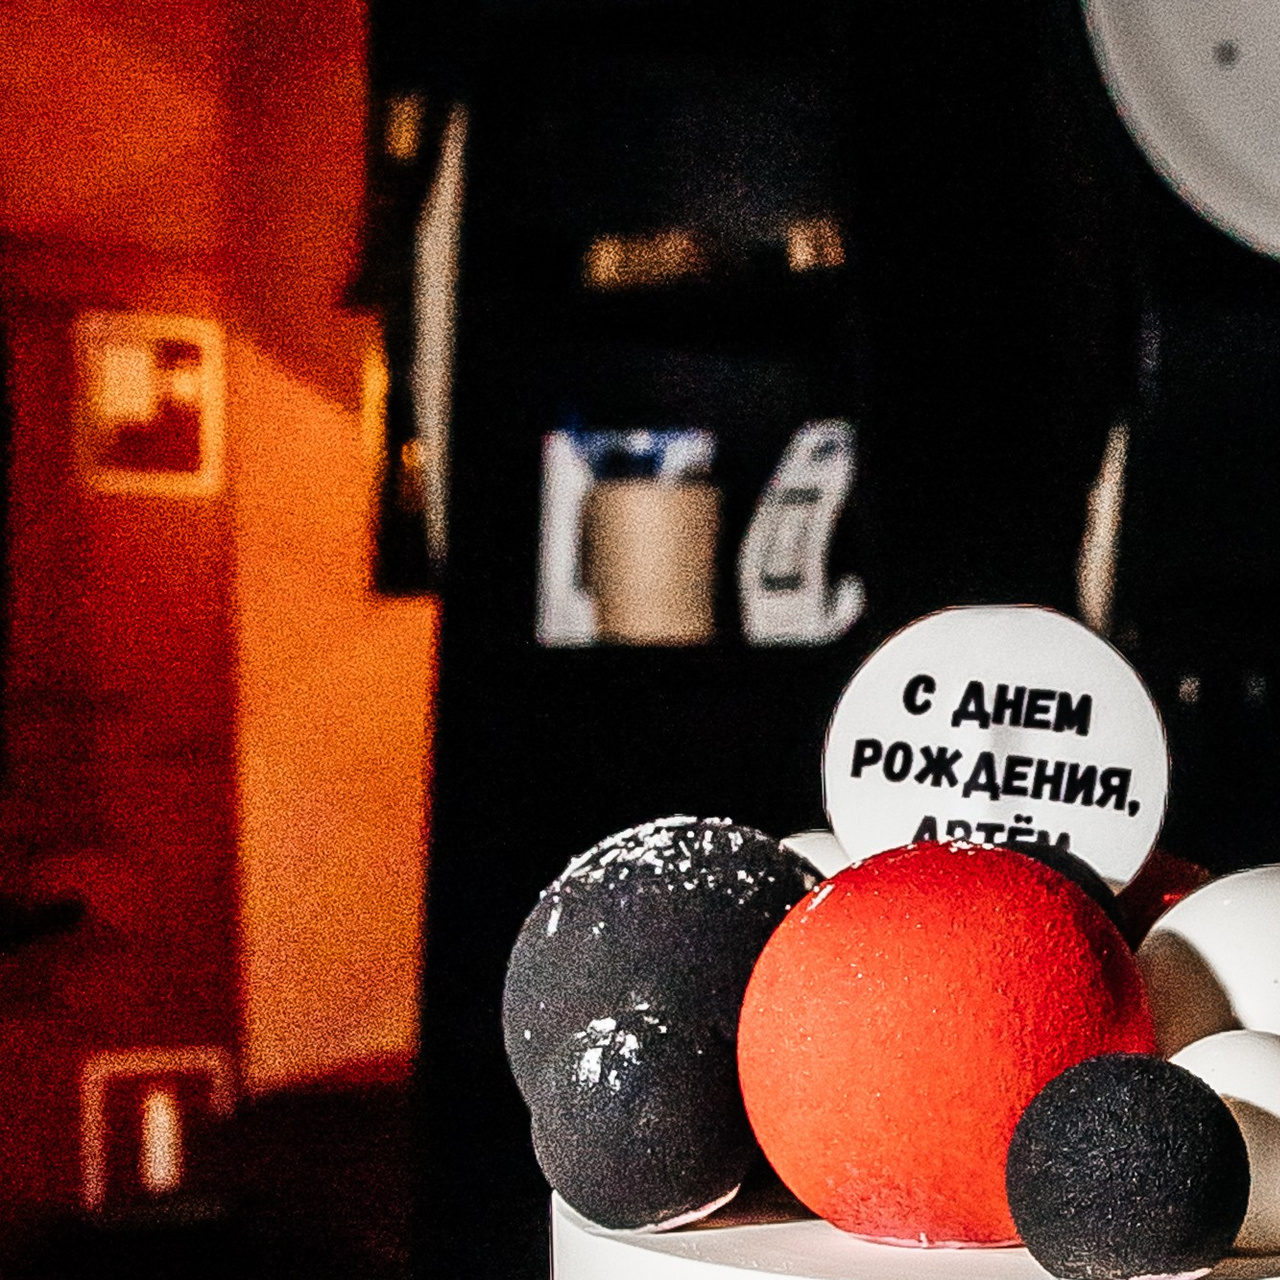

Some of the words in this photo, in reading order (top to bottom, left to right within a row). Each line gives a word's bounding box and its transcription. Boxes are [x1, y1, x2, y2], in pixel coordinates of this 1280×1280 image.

[902, 674, 937, 715] С
[951, 680, 1093, 737] ДНЕМ
[850, 738, 1141, 817] РОЖДЕНИЯ,
